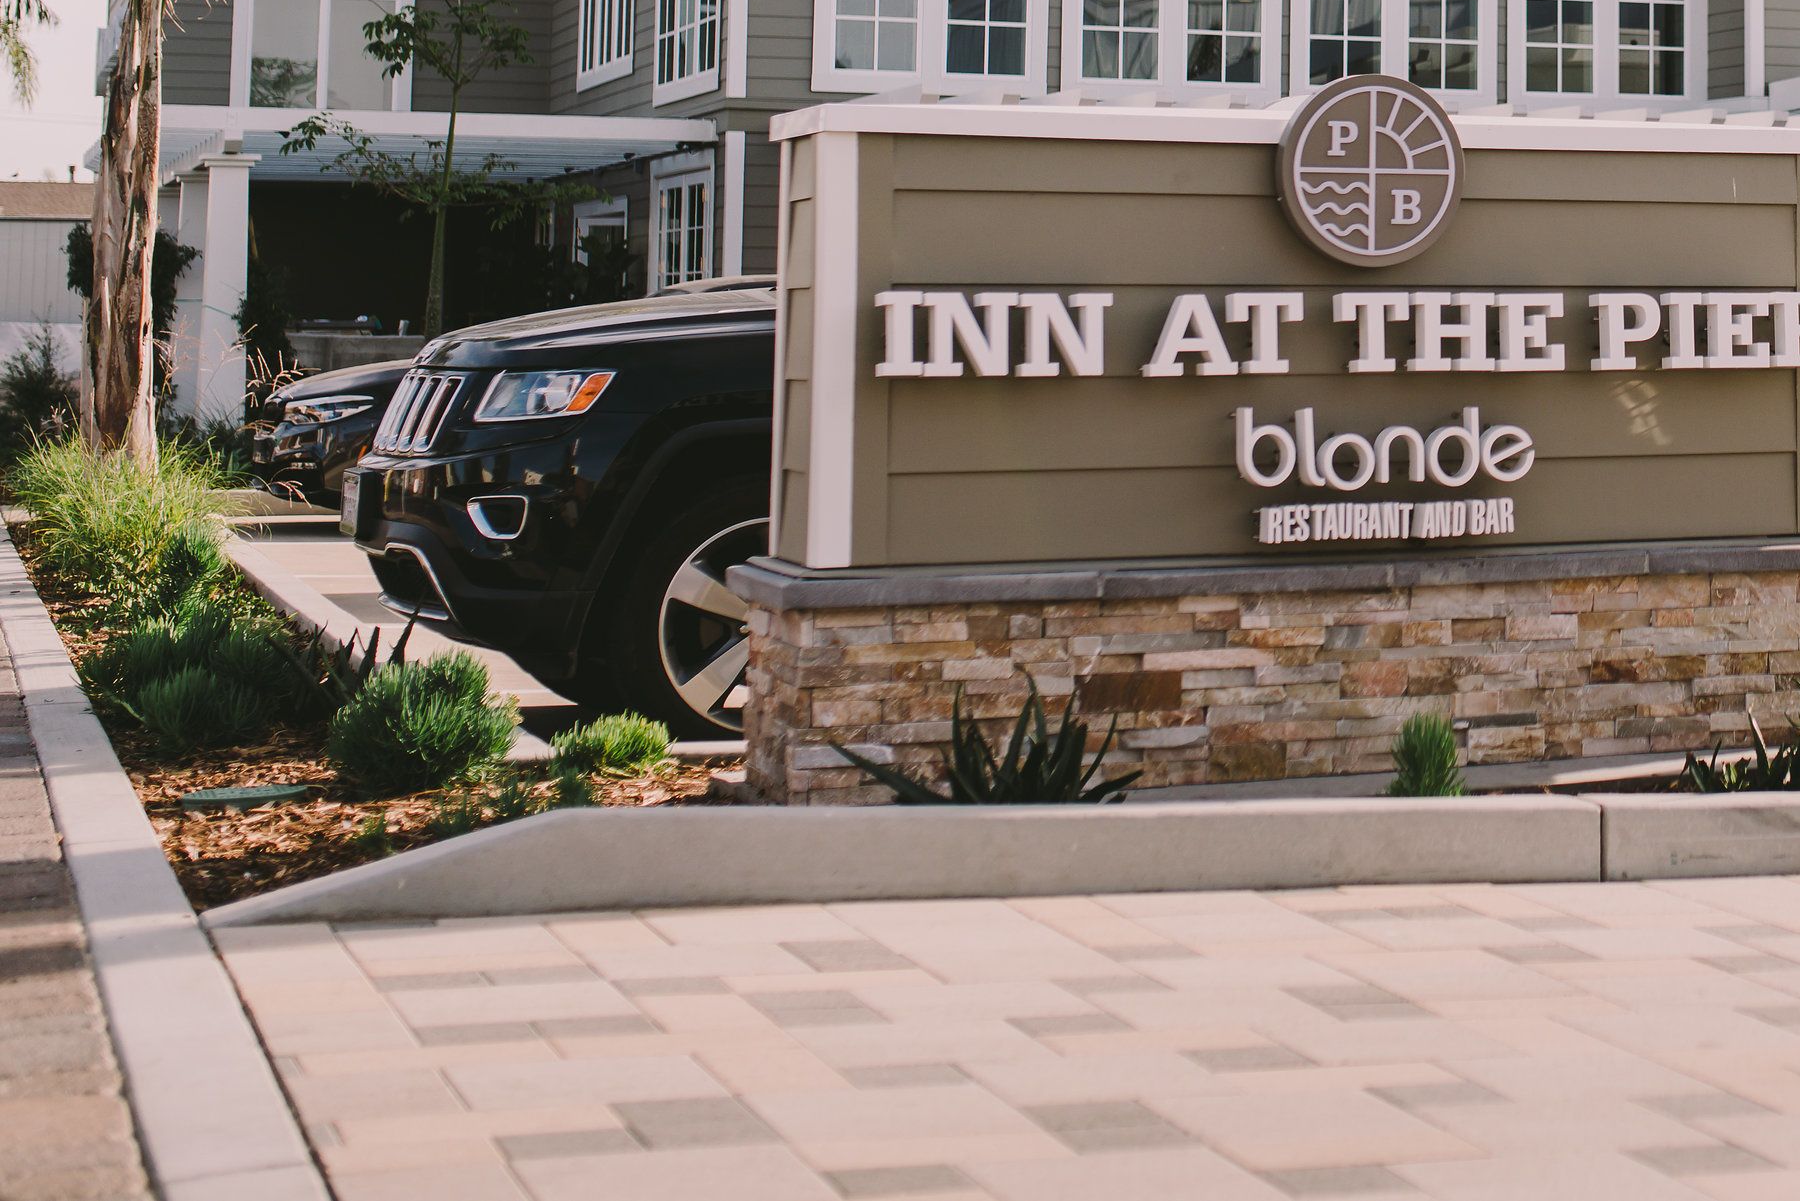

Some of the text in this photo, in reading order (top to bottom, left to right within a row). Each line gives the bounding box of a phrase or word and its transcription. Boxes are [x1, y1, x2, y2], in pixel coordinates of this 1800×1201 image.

[1327, 120, 1359, 157] P
[1390, 189, 1422, 225] B
[874, 290, 1114, 377] INN
[1140, 292, 1304, 377] AT
[1332, 291, 1566, 373] THE
[1235, 406, 1536, 492] blonde
[1258, 497, 1515, 544] RESTAURANT AND BAR
